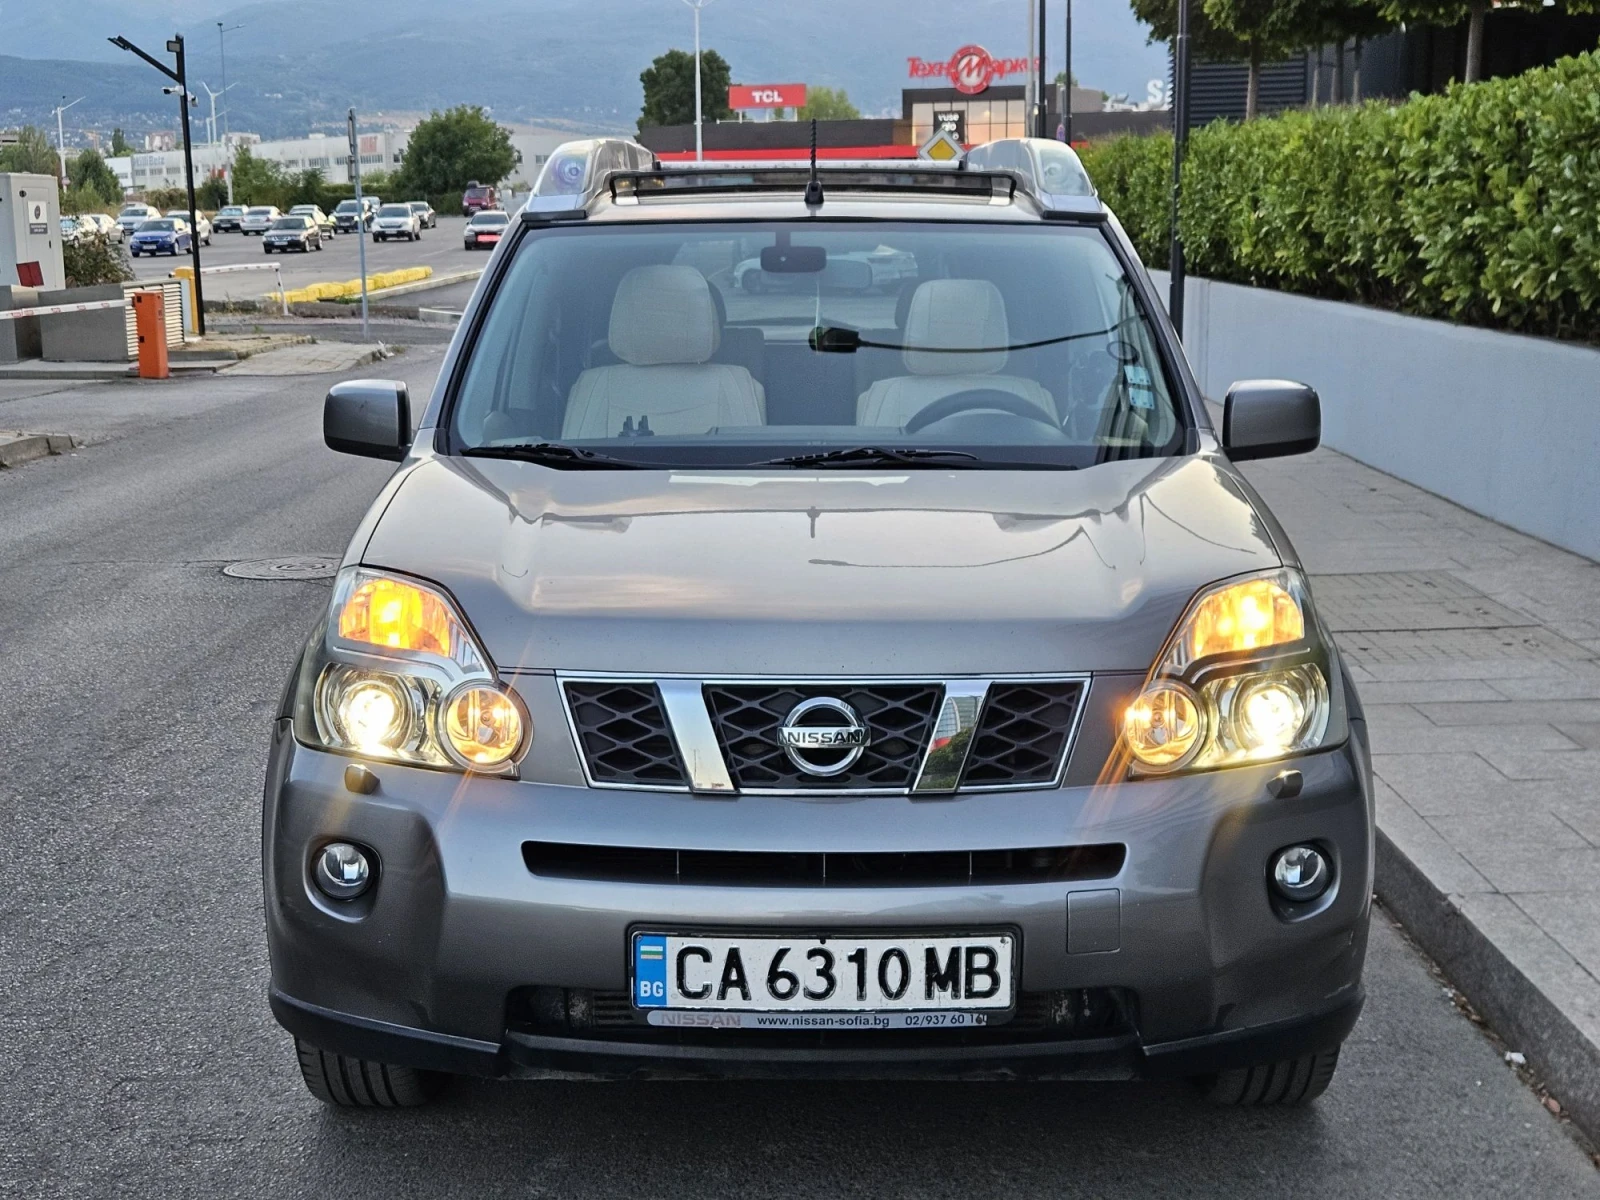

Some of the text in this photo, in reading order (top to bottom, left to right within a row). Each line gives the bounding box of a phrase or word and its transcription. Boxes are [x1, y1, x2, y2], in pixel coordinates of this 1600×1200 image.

[752, 89, 783, 103] TCL
[787, 731, 862, 743] NISSAN
[676, 945, 1001, 1001] CA 6310 MB
[640, 981, 663, 997] BG
[661, 1013, 741, 1027] NISSAN
[757, 1015, 890, 1028] www.nissan-sofia.bg
[905, 1015, 947, 1026] 02/937
[950, 1014, 965, 1025] 60
